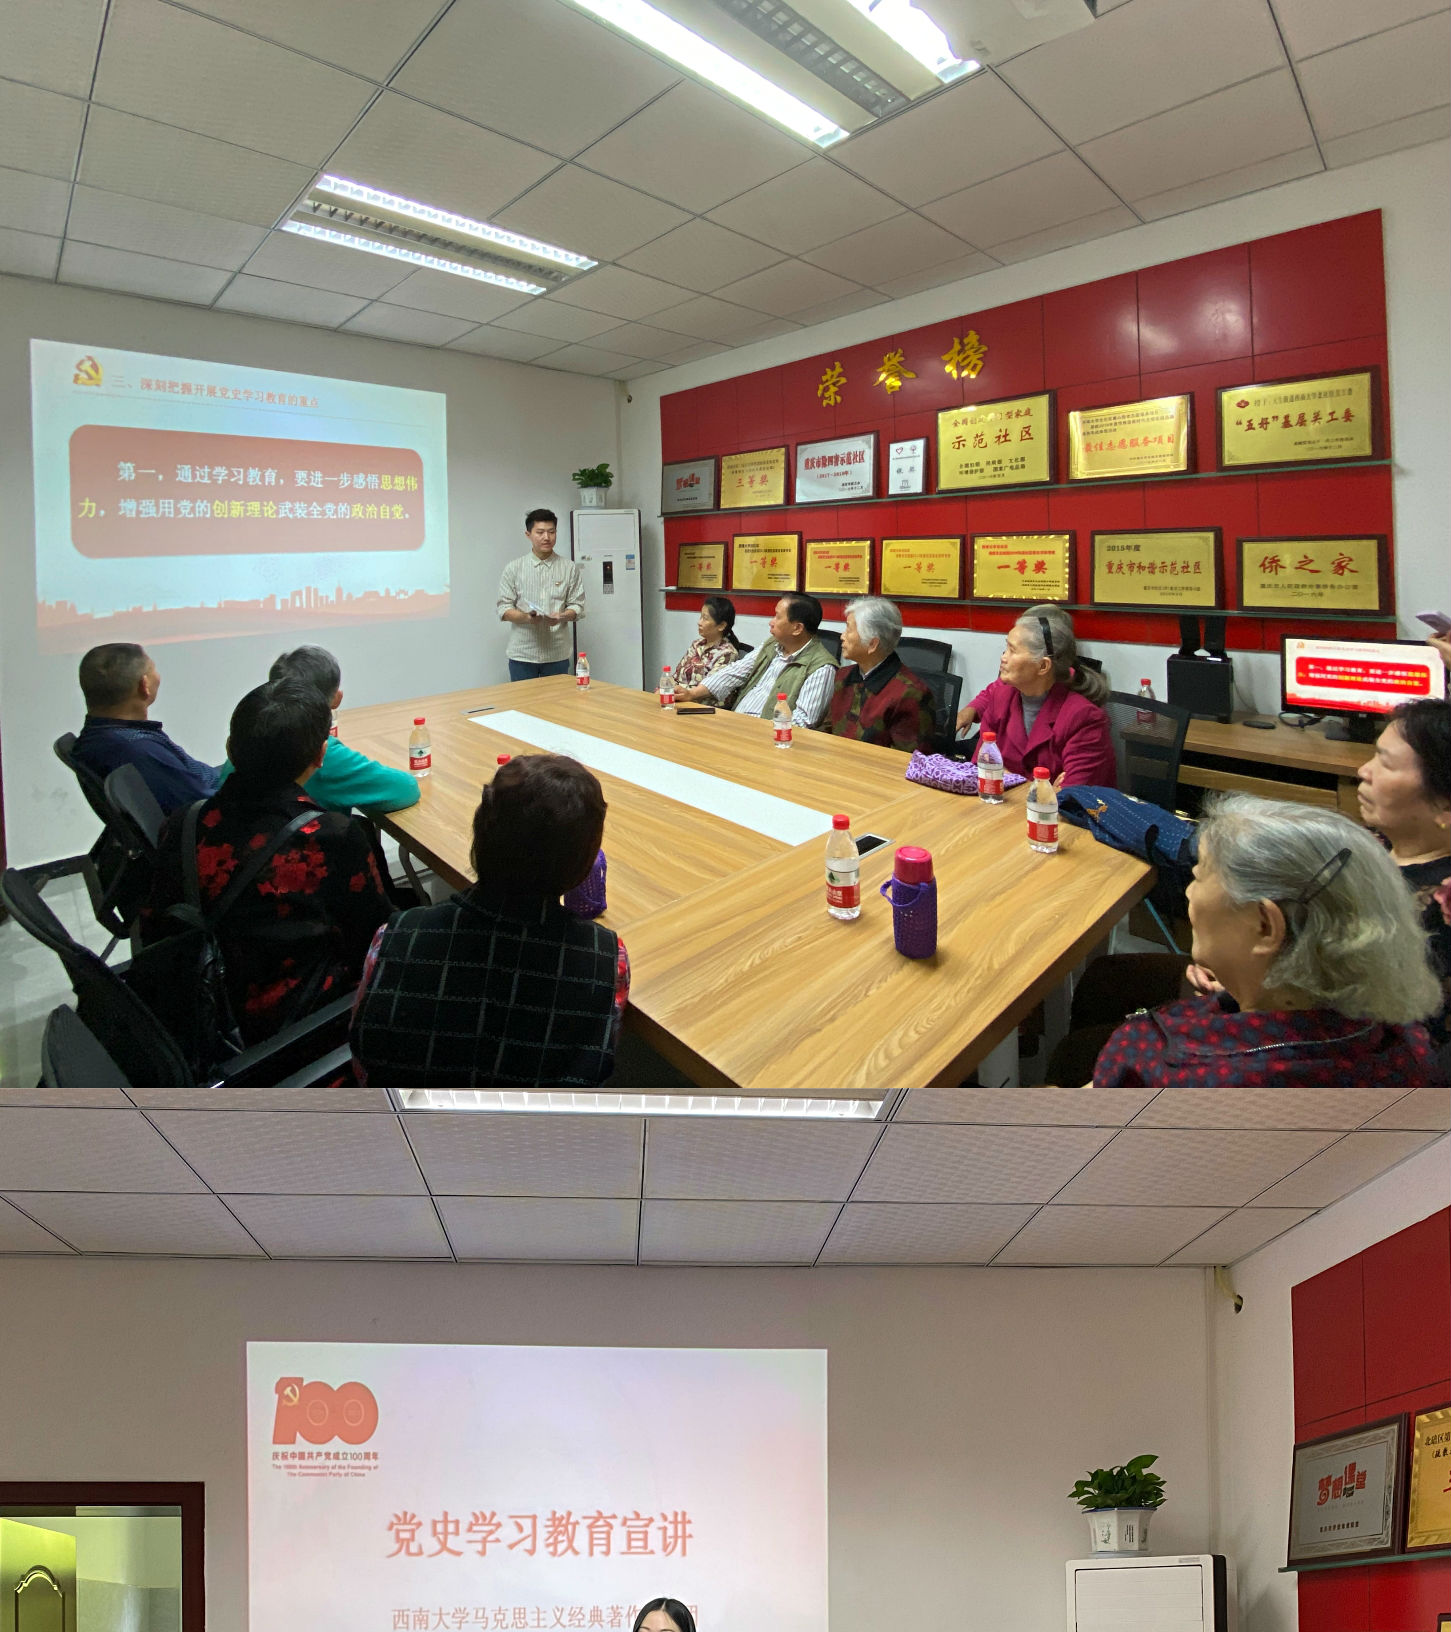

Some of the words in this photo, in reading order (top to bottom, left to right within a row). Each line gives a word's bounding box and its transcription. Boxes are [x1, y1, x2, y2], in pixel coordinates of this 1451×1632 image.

[817, 330, 989, 407] 荣誉榜
[952, 425, 1033, 450] 示范社区
[903, 561, 935, 574] 一等奖
[997, 559, 1048, 575] 一等奖
[1259, 552, 1359, 577] 侨之家
[272, 1451, 379, 1461] 庆祝中国共产党成立100周年
[385, 1508, 694, 1559] 党史学习教育宣讲
[392, 1604, 698, 1631] 西南大学马克思主义经典著作
